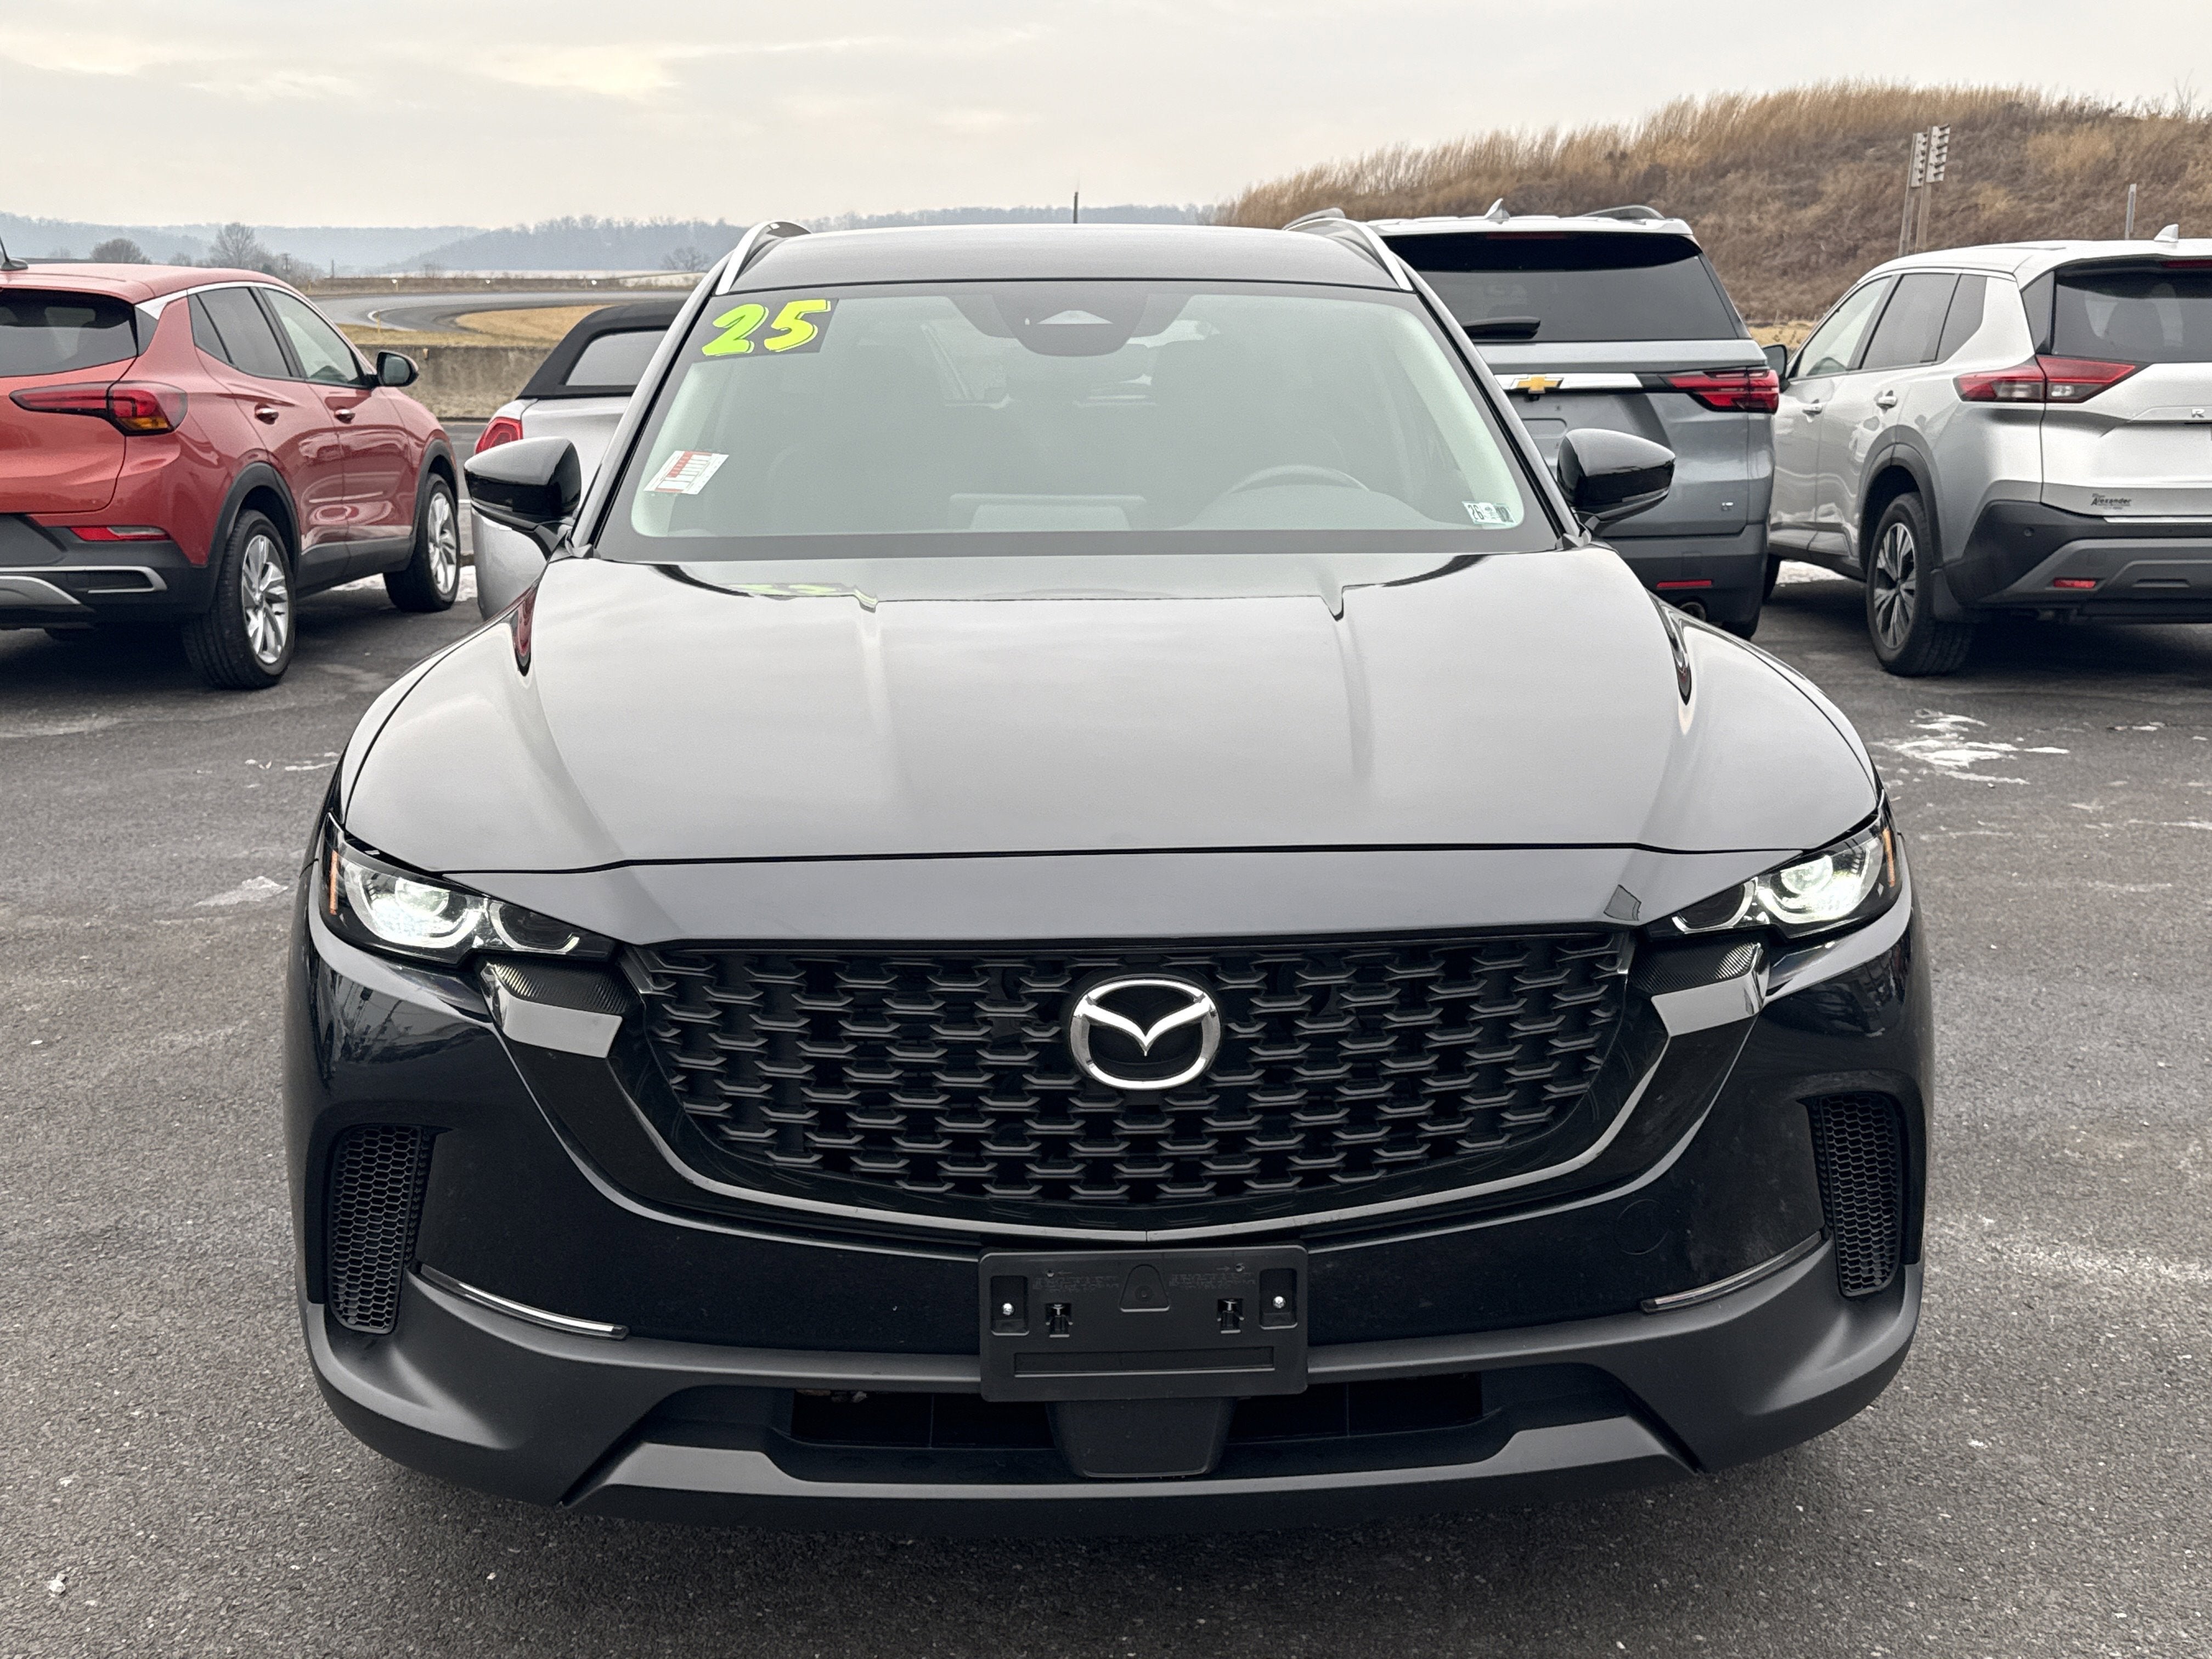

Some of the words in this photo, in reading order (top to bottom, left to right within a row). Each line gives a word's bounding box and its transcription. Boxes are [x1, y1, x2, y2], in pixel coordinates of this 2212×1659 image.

[702, 299, 831, 356] 25
[2191, 408, 2205, 418] R
[1467, 504, 1485, 520] 26
